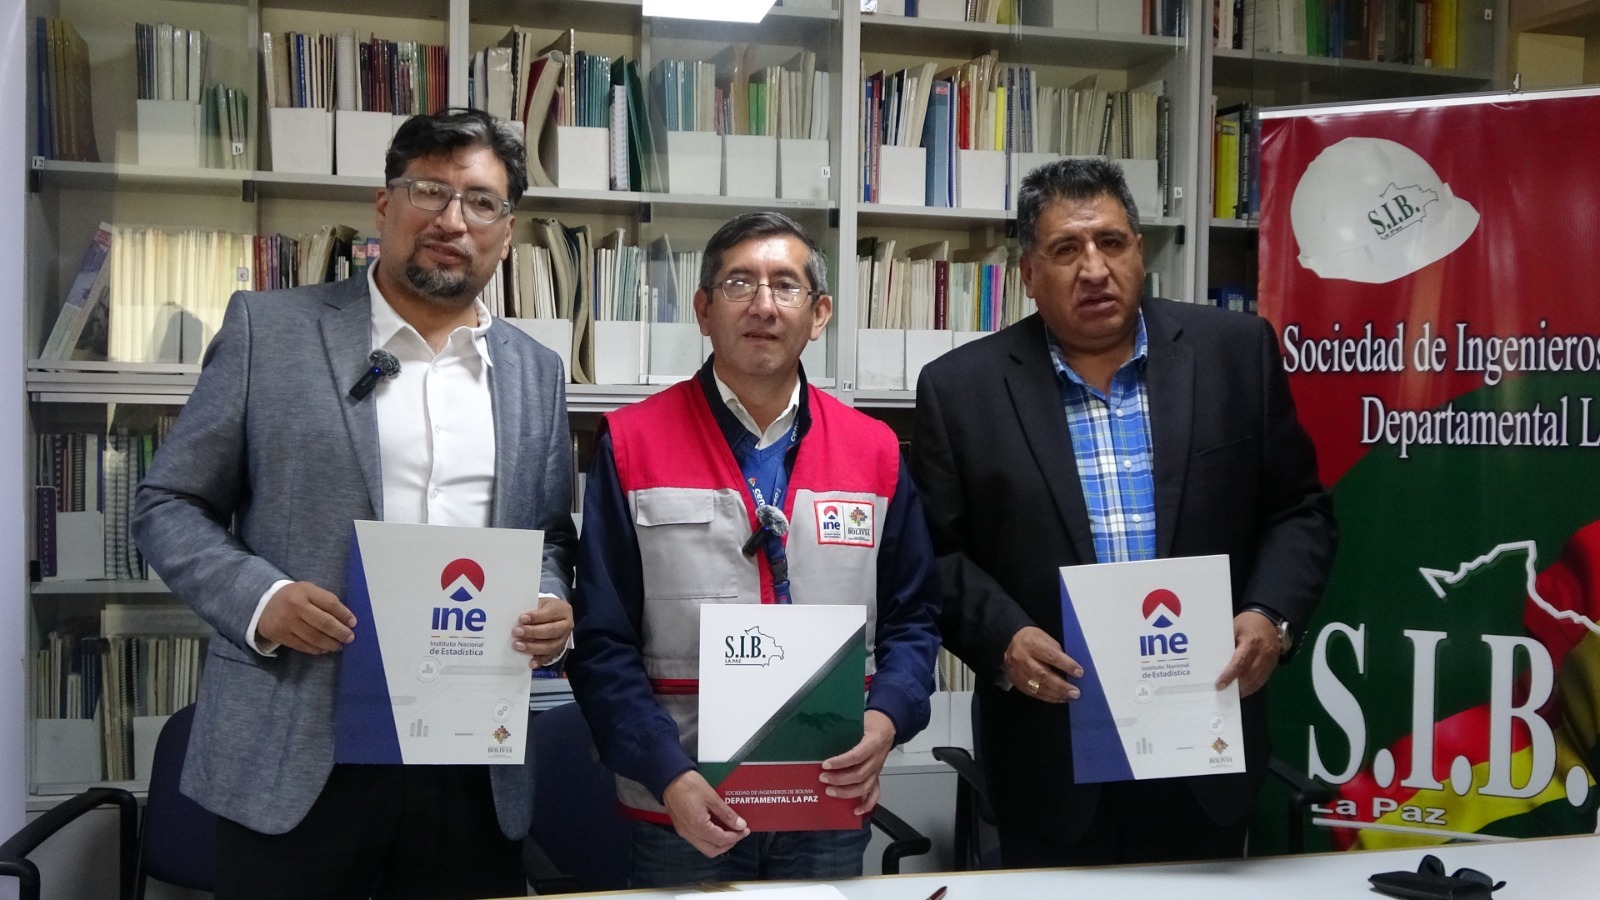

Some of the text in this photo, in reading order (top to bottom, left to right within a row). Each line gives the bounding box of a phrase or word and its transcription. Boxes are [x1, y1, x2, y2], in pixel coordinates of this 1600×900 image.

[34, 159, 44, 167] 12
[1368, 194, 1420, 235] S.I.B.
[1283, 322, 1404, 372] Sociedad
[1413, 322, 1446, 372] de
[1361, 395, 1569, 458] Departamental
[823, 521, 841, 530] ine
[431, 607, 487, 632] ine
[429, 647, 440, 655] de
[430, 640, 457, 648] Instituto
[725, 635, 767, 659] S.I.B.
[1139, 632, 1189, 657] ine
[1141, 662, 1190, 672] Instituto Nacional
[1142, 671, 1151, 679] de
[1308, 622, 1589, 807] S.I.B.
[724, 796, 791, 804] DEPARTAMENTAL
[803, 795, 819, 803] PAZ
[1372, 797, 1447, 825] Paz
